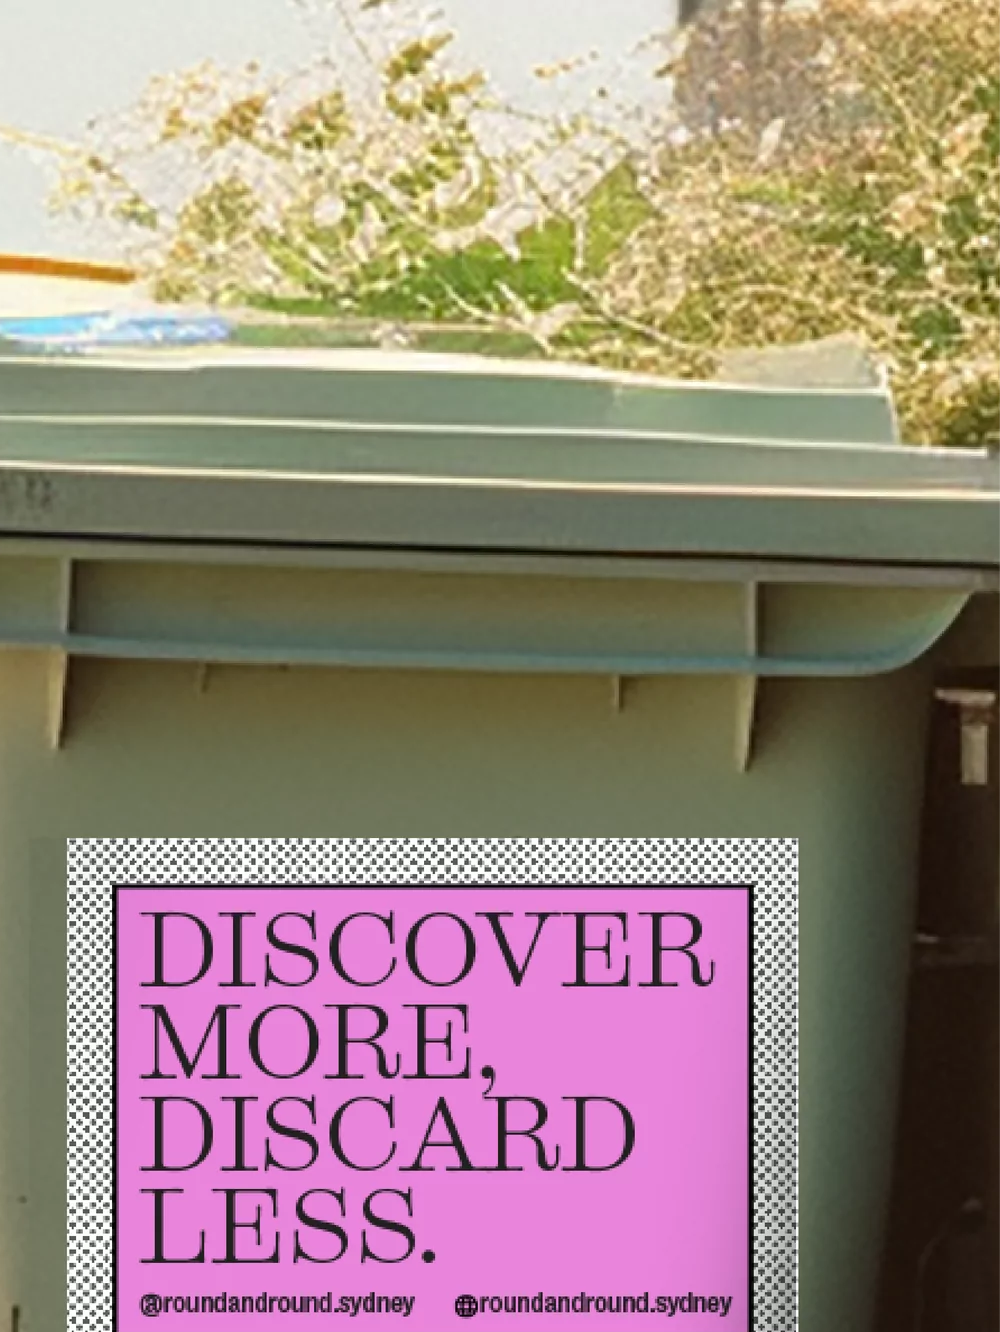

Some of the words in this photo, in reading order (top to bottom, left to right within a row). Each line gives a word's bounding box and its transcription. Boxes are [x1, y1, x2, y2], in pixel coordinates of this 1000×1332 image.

[139, 910, 715, 987] DISCOVER
[139, 1004, 497, 1096] MORE,
[139, 1095, 636, 1171] DISCARD
[139, 1187, 436, 1263] LESS.
[139, 1292, 415, 1318] @roundandround.sydney
[479, 1292, 734, 1318] roundandround.sydney
